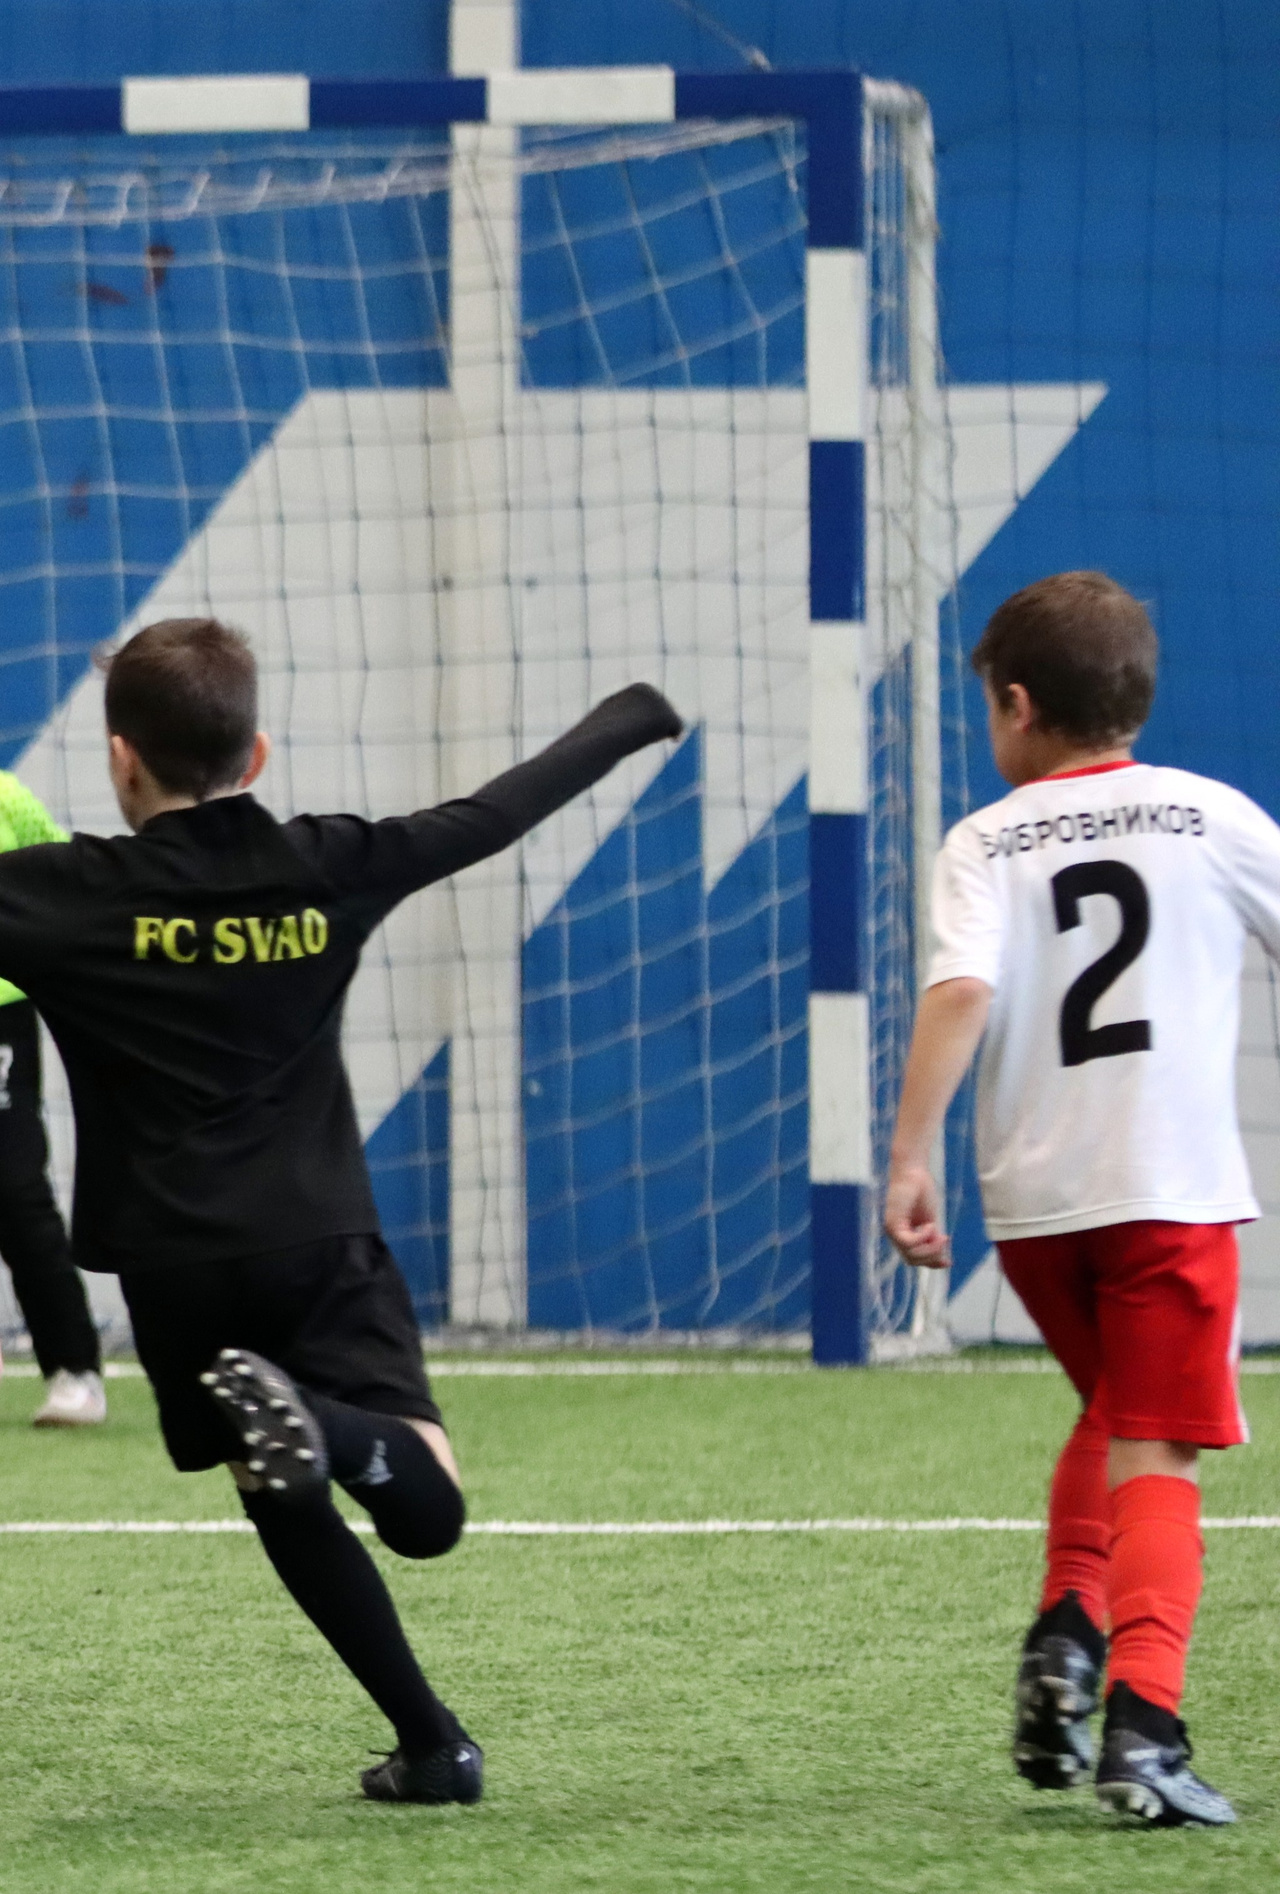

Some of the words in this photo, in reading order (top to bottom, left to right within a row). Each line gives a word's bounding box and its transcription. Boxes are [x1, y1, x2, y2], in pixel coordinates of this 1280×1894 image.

[134, 916, 197, 963] FC
[214, 908, 328, 964] SVAO
[1051, 860, 1153, 1067] 2
